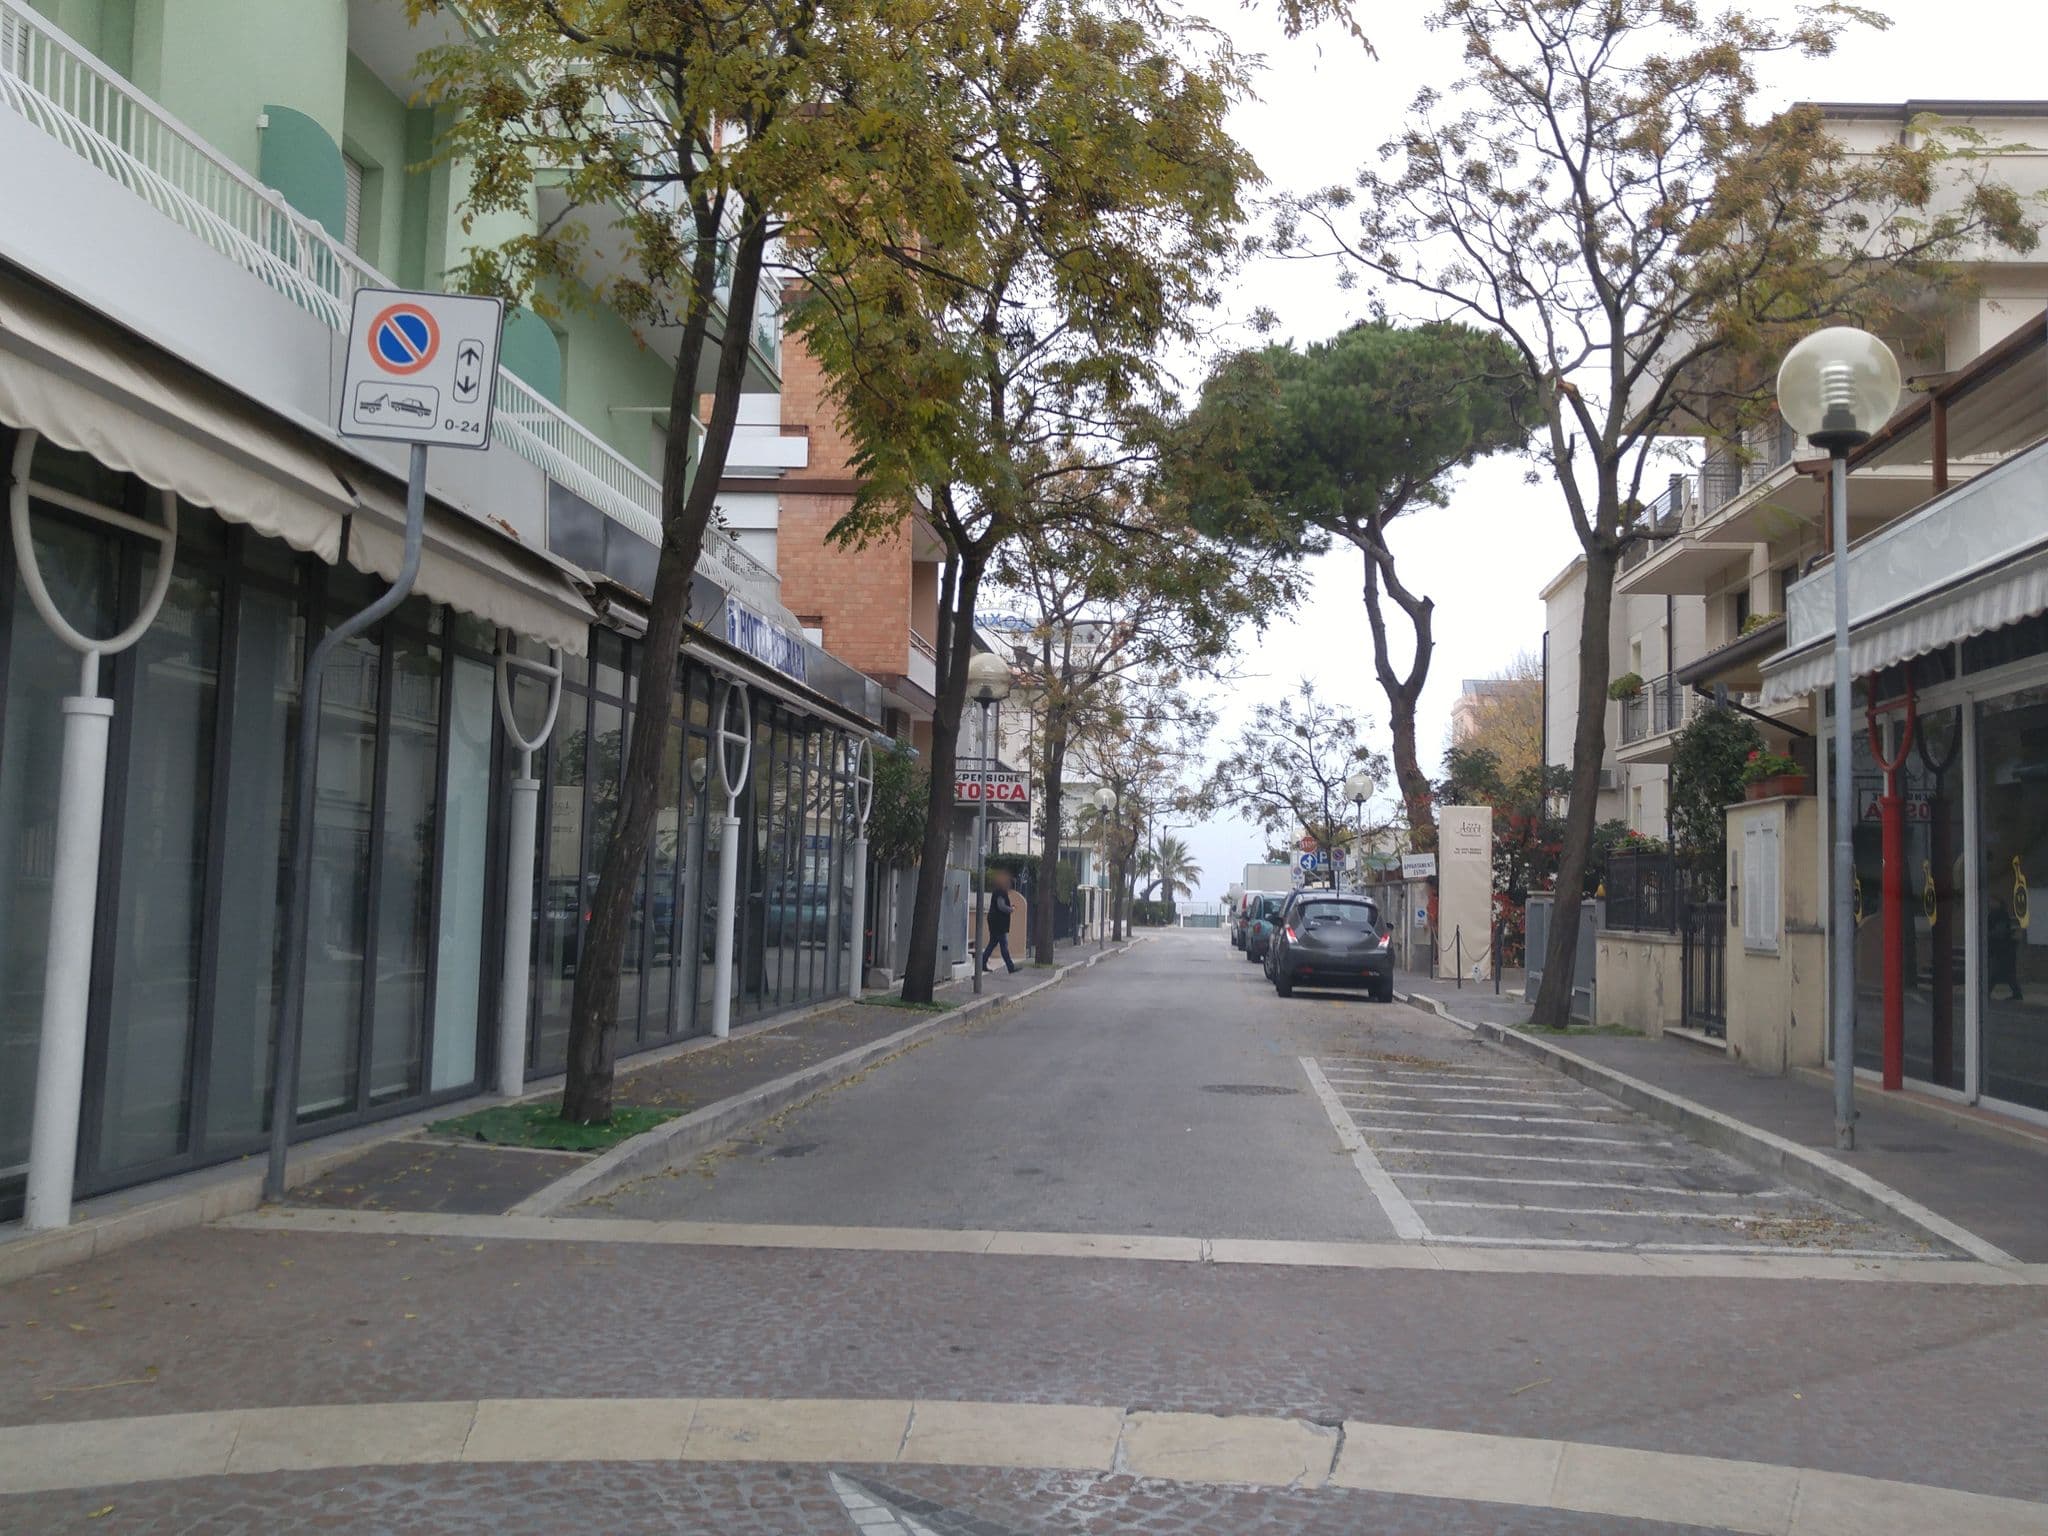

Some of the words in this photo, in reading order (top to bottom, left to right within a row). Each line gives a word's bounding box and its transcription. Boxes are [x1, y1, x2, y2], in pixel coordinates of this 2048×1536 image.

[445, 418, 480, 434] 0-24
[955, 783, 1027, 801] TOSCA
[1319, 851, 1328, 863] P
